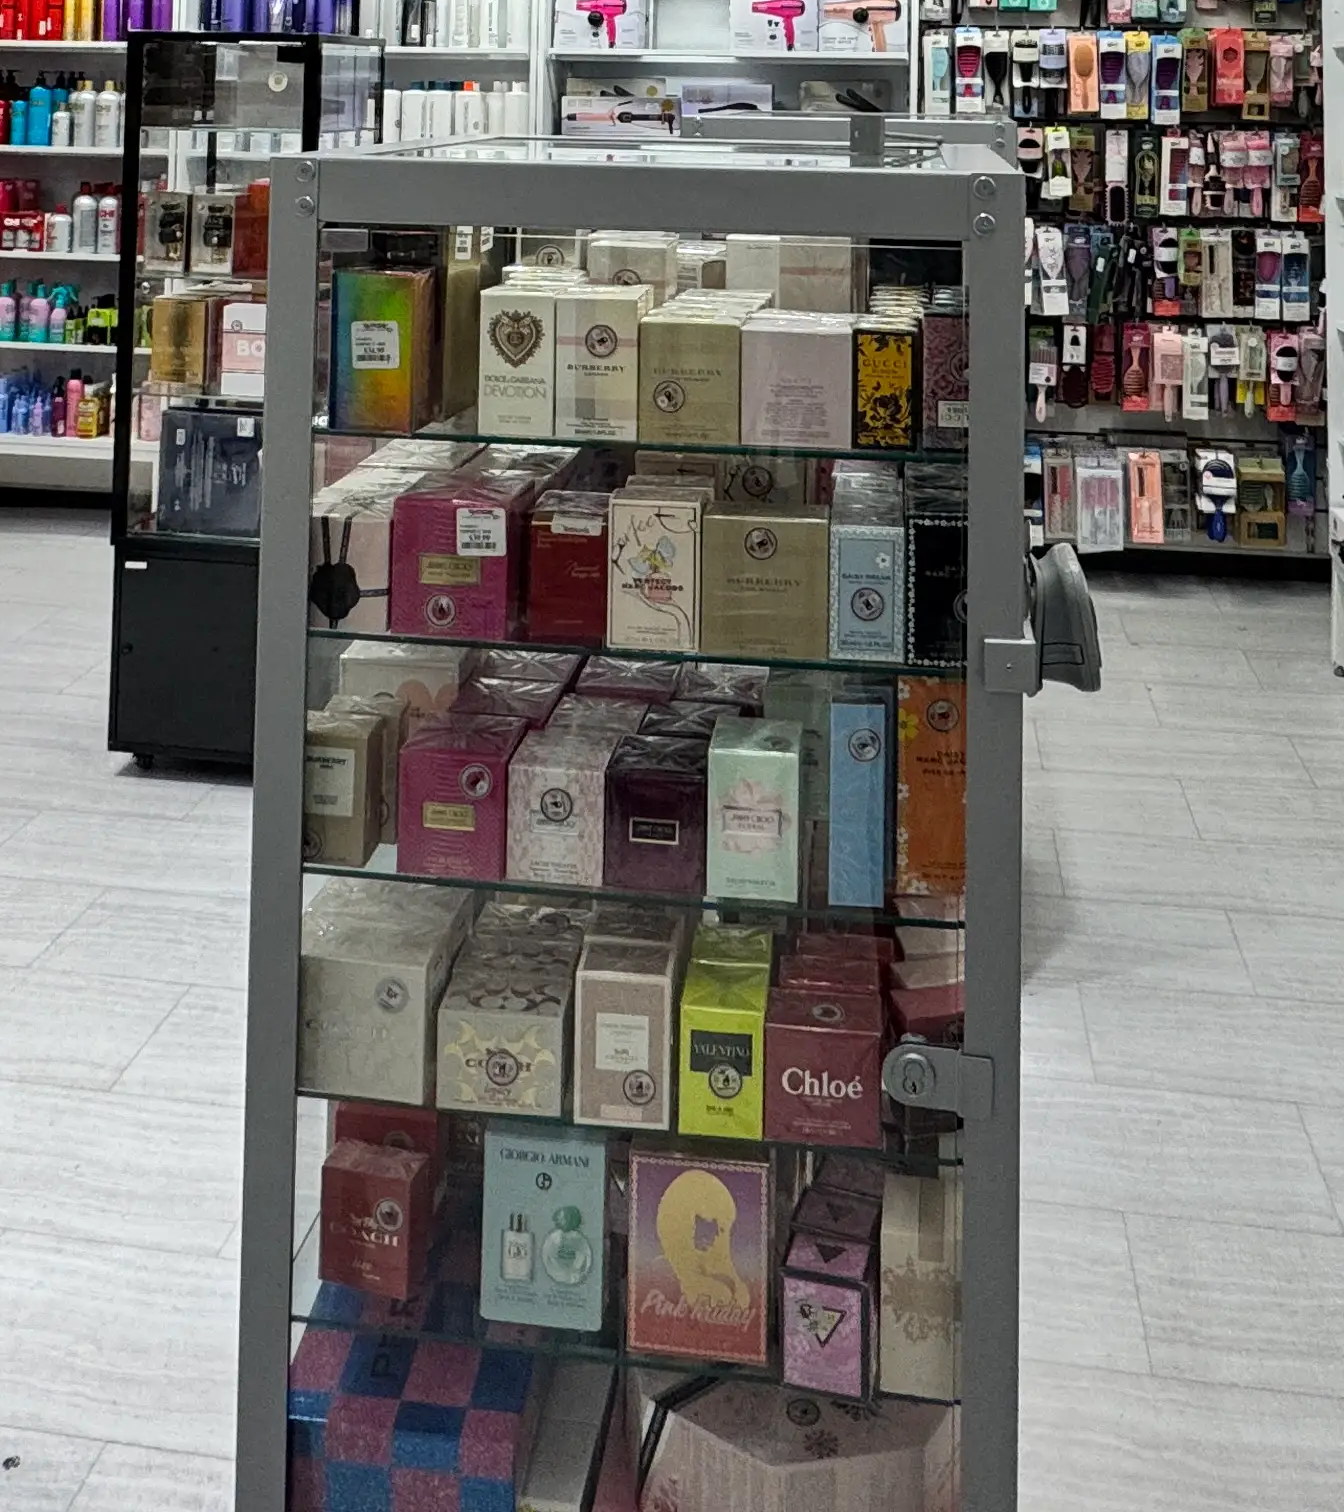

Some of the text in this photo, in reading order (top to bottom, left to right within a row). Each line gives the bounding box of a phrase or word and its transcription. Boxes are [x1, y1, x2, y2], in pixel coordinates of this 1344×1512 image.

[565, 363, 627, 373] BURBERRY
[862, 357, 908, 370] GUCCI
[483, 384, 548, 400] DEVOTION
[692, 1042, 752, 1059] VALENTINO
[464, 1057, 533, 1074] COH
[781, 1065, 864, 1100] Chloé
[499, 1148, 590, 1169] GIORGIO ARMANI
[639, 1287, 758, 1332] Pink Friday
